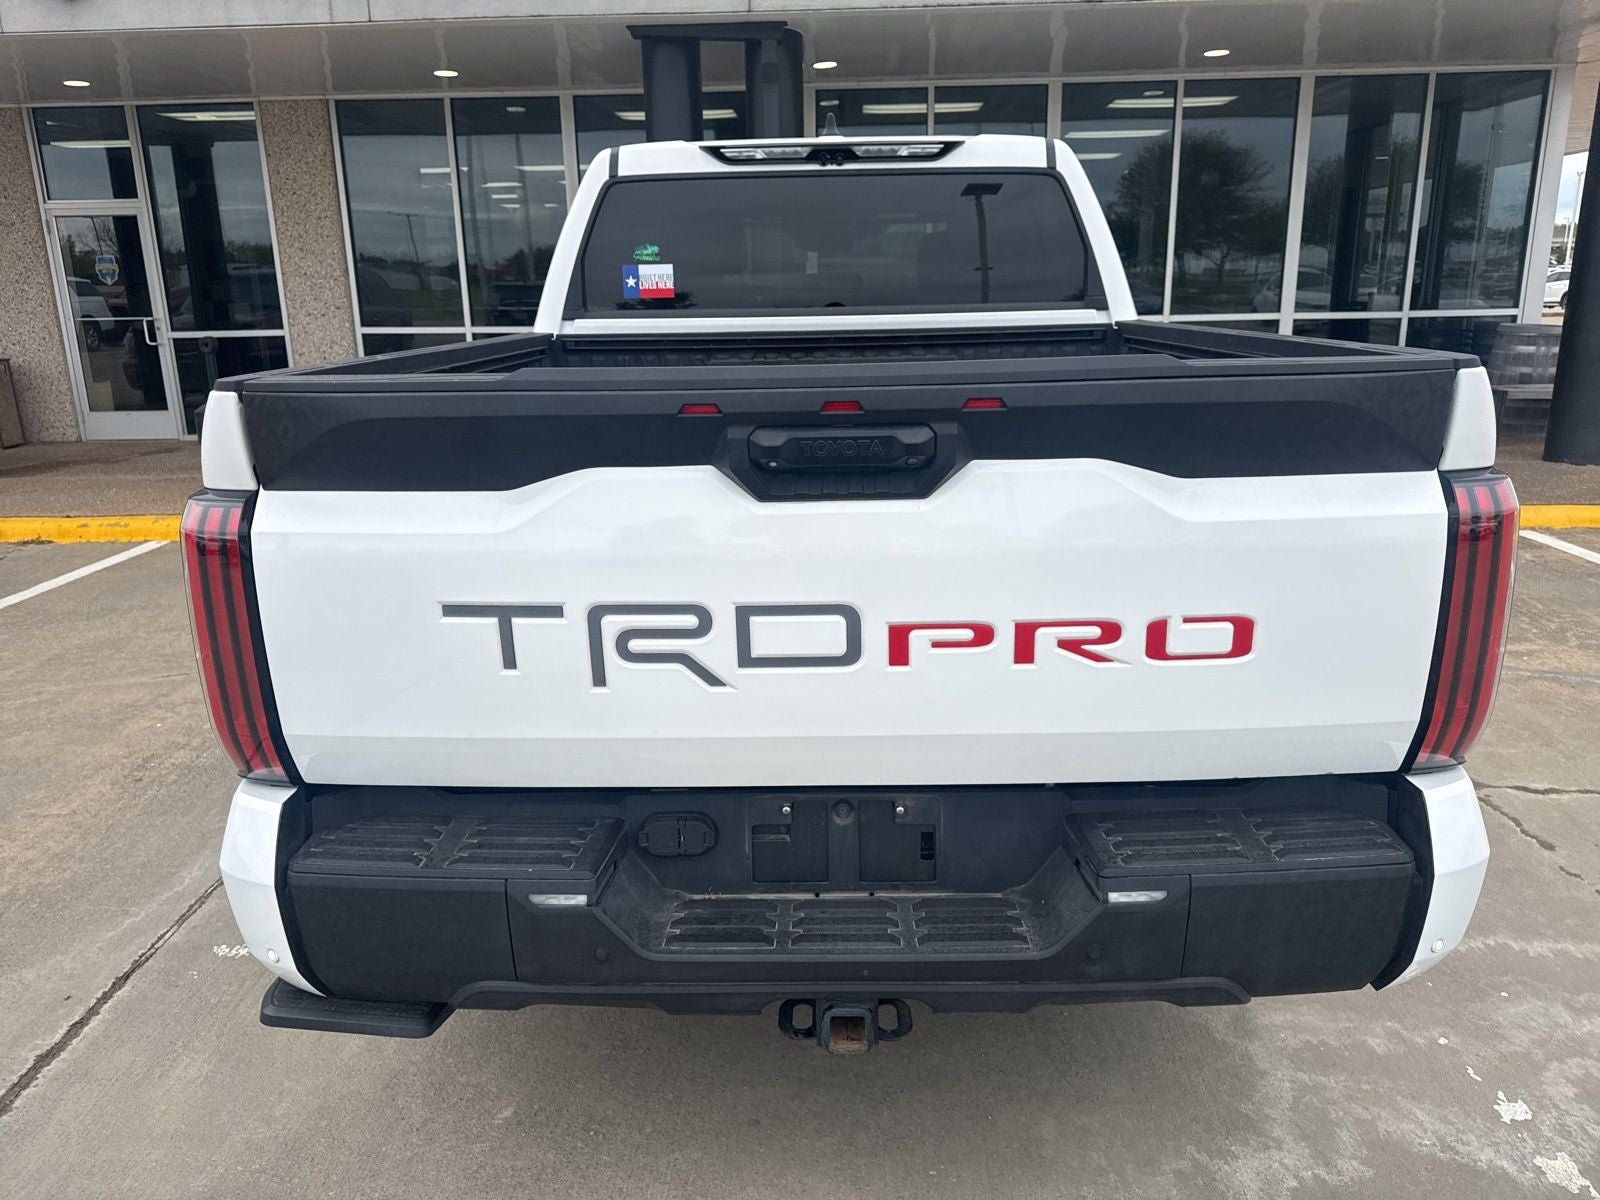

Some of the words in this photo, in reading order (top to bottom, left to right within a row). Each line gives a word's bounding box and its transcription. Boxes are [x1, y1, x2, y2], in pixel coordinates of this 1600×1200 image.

[657, 273, 673, 281] HERE
[640, 281, 657, 289] LIVES
[658, 280, 674, 288] HERE
[800, 439, 886, 457] TOYOTA
[440, 602, 864, 691] TRD
[887, 614, 1256, 668] PRO
